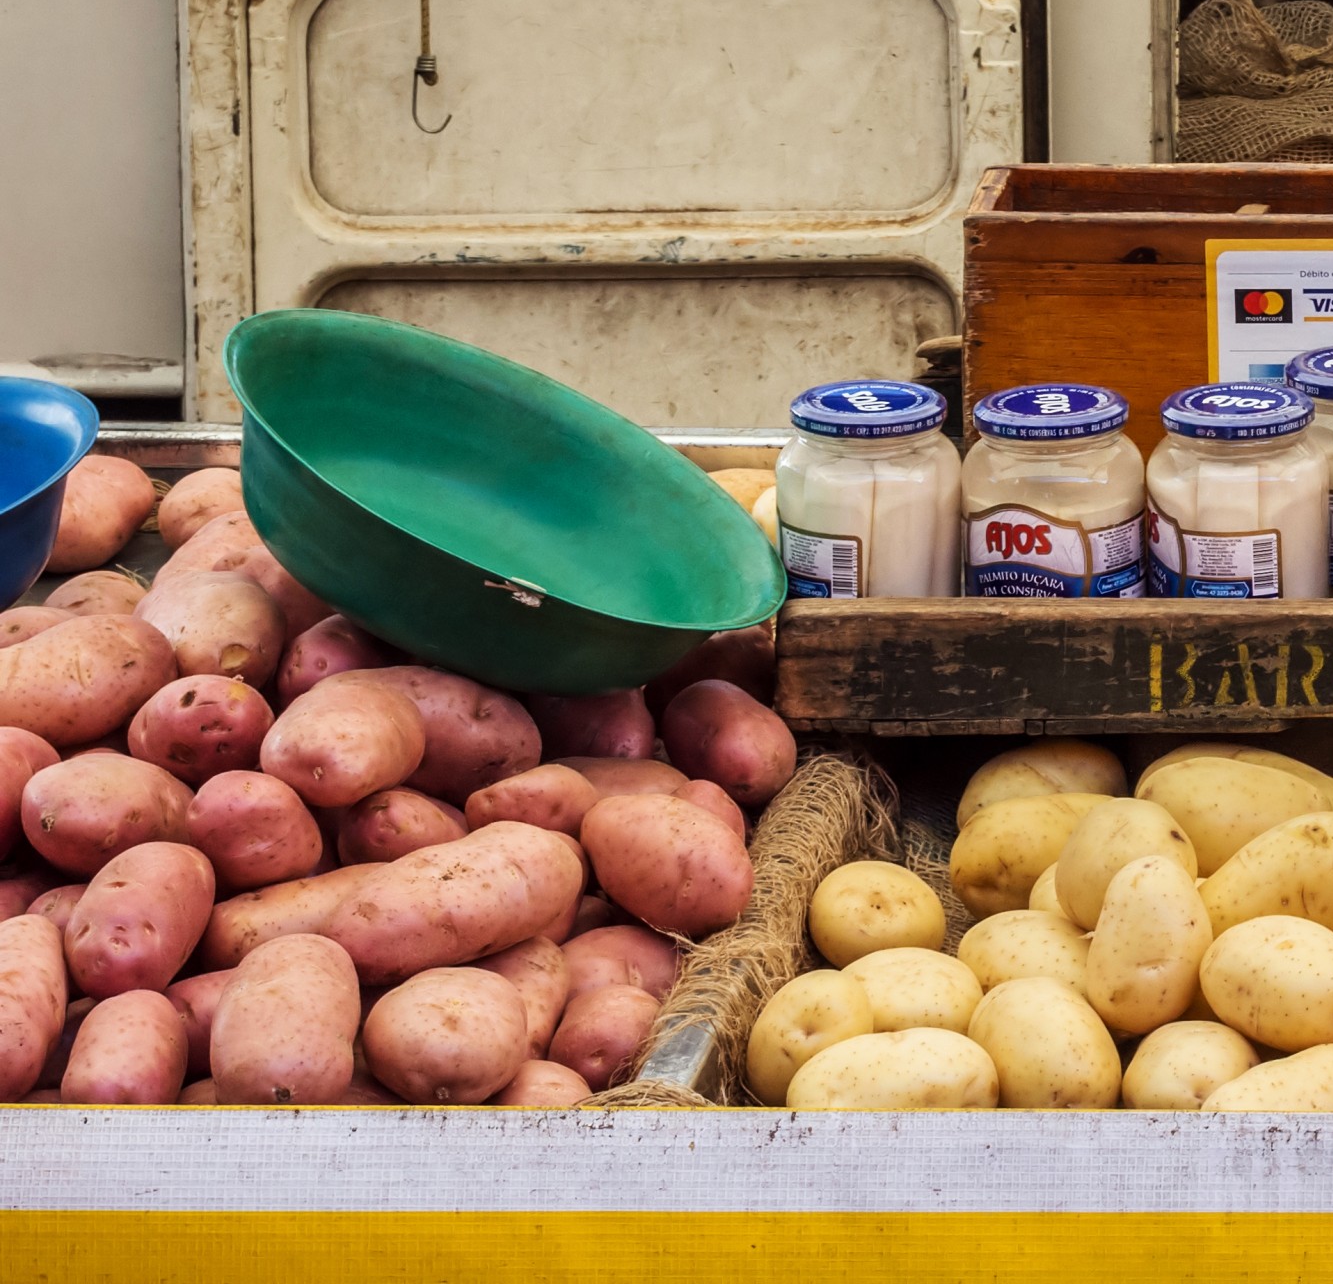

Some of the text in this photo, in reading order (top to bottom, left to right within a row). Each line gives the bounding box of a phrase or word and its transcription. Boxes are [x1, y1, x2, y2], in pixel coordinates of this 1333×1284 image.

[1299, 270, 1329, 278] Débito
[1202, 395, 1275, 409] AJOS
[1028, 428, 1056, 437] CONSERVAS
[986, 521, 1053, 560] AJOS
[979, 570, 1065, 592] PALMITO JUÇARA
